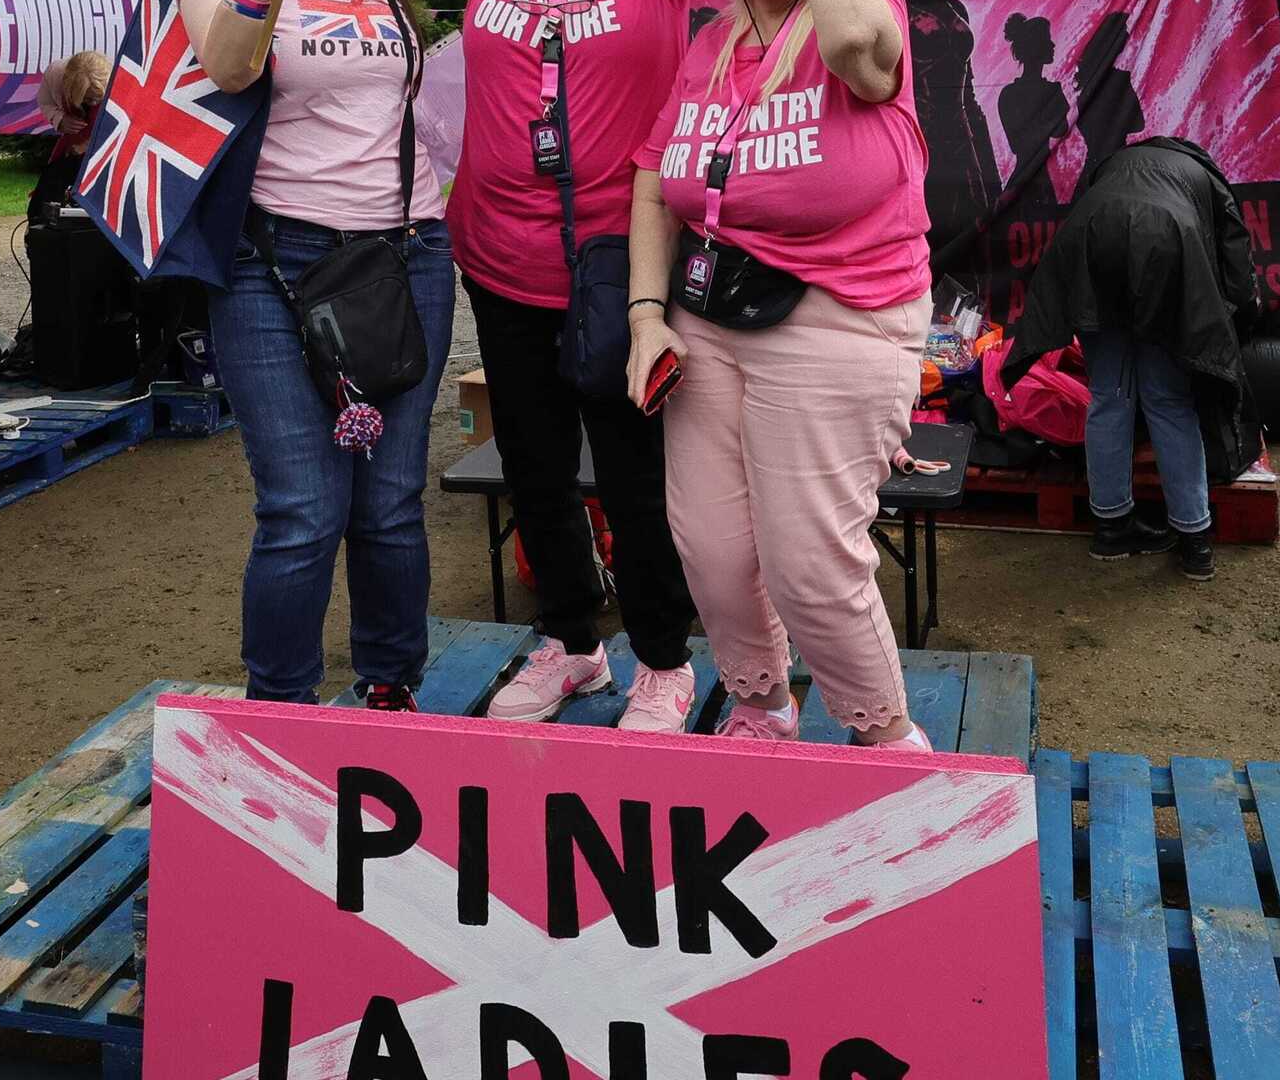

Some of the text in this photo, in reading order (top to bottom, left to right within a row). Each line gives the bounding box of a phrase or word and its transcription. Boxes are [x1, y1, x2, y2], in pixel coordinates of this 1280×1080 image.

[301, 38, 418, 62] NOT RACIT
[660, 126, 823, 179] UR FTURE
[335, 766, 778, 959] PINK
